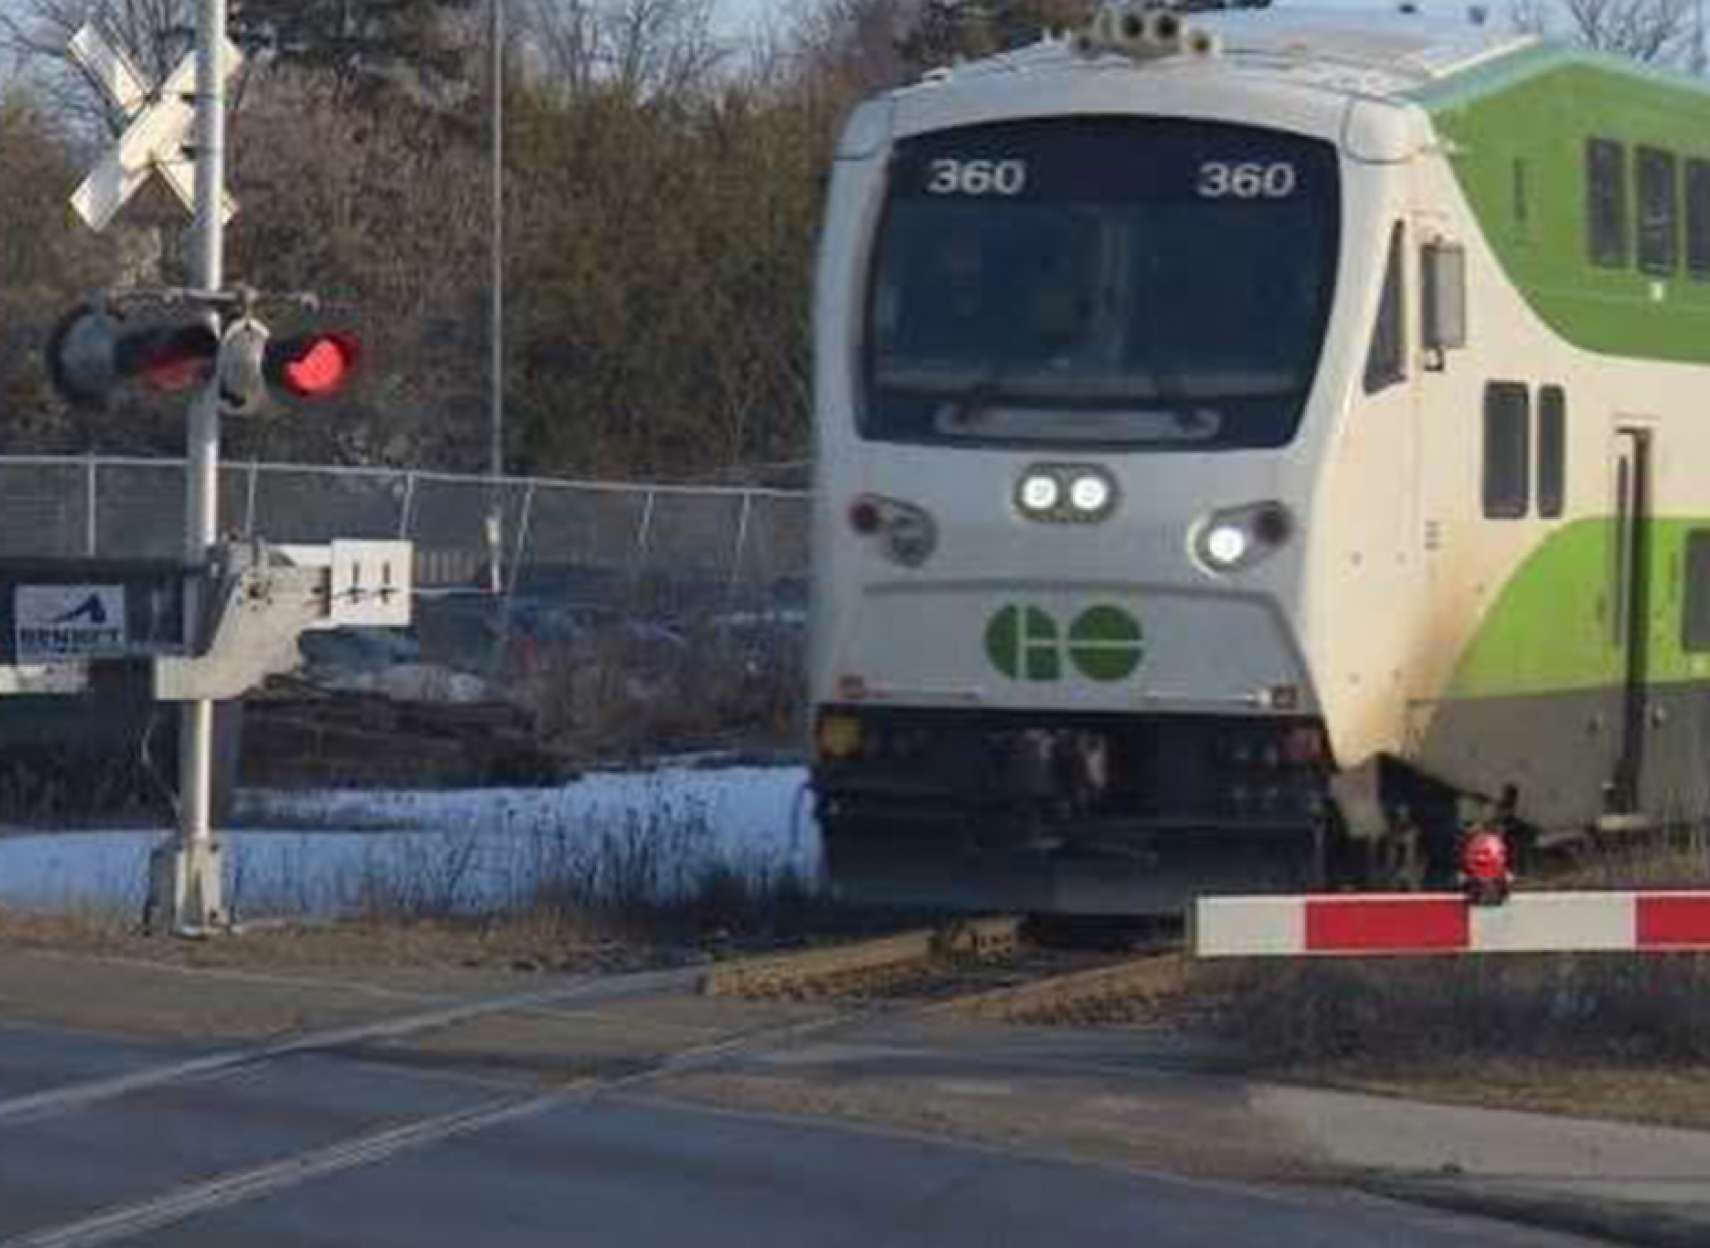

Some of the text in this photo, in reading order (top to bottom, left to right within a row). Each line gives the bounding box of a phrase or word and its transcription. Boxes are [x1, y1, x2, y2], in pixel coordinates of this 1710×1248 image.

[927, 158, 1027, 195] 360
[1198, 161, 1296, 198] 360
[985, 603, 1144, 682] GO
